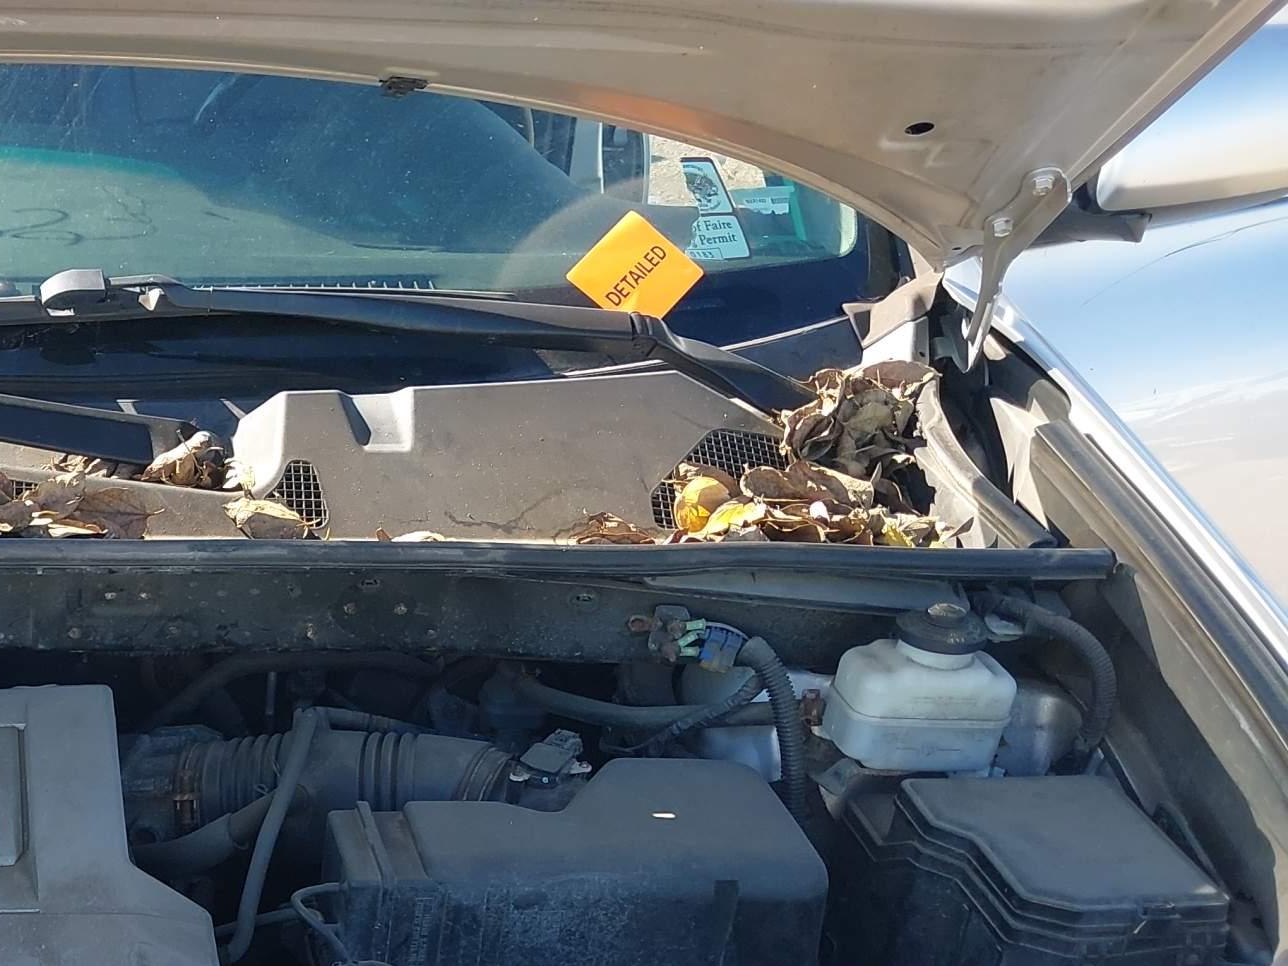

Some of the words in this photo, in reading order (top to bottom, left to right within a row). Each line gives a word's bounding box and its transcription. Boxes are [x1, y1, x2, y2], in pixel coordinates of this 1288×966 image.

[704, 220, 732, 232] Faire
[699, 233, 737, 246] Permit
[605, 245, 667, 307] DETAILED
